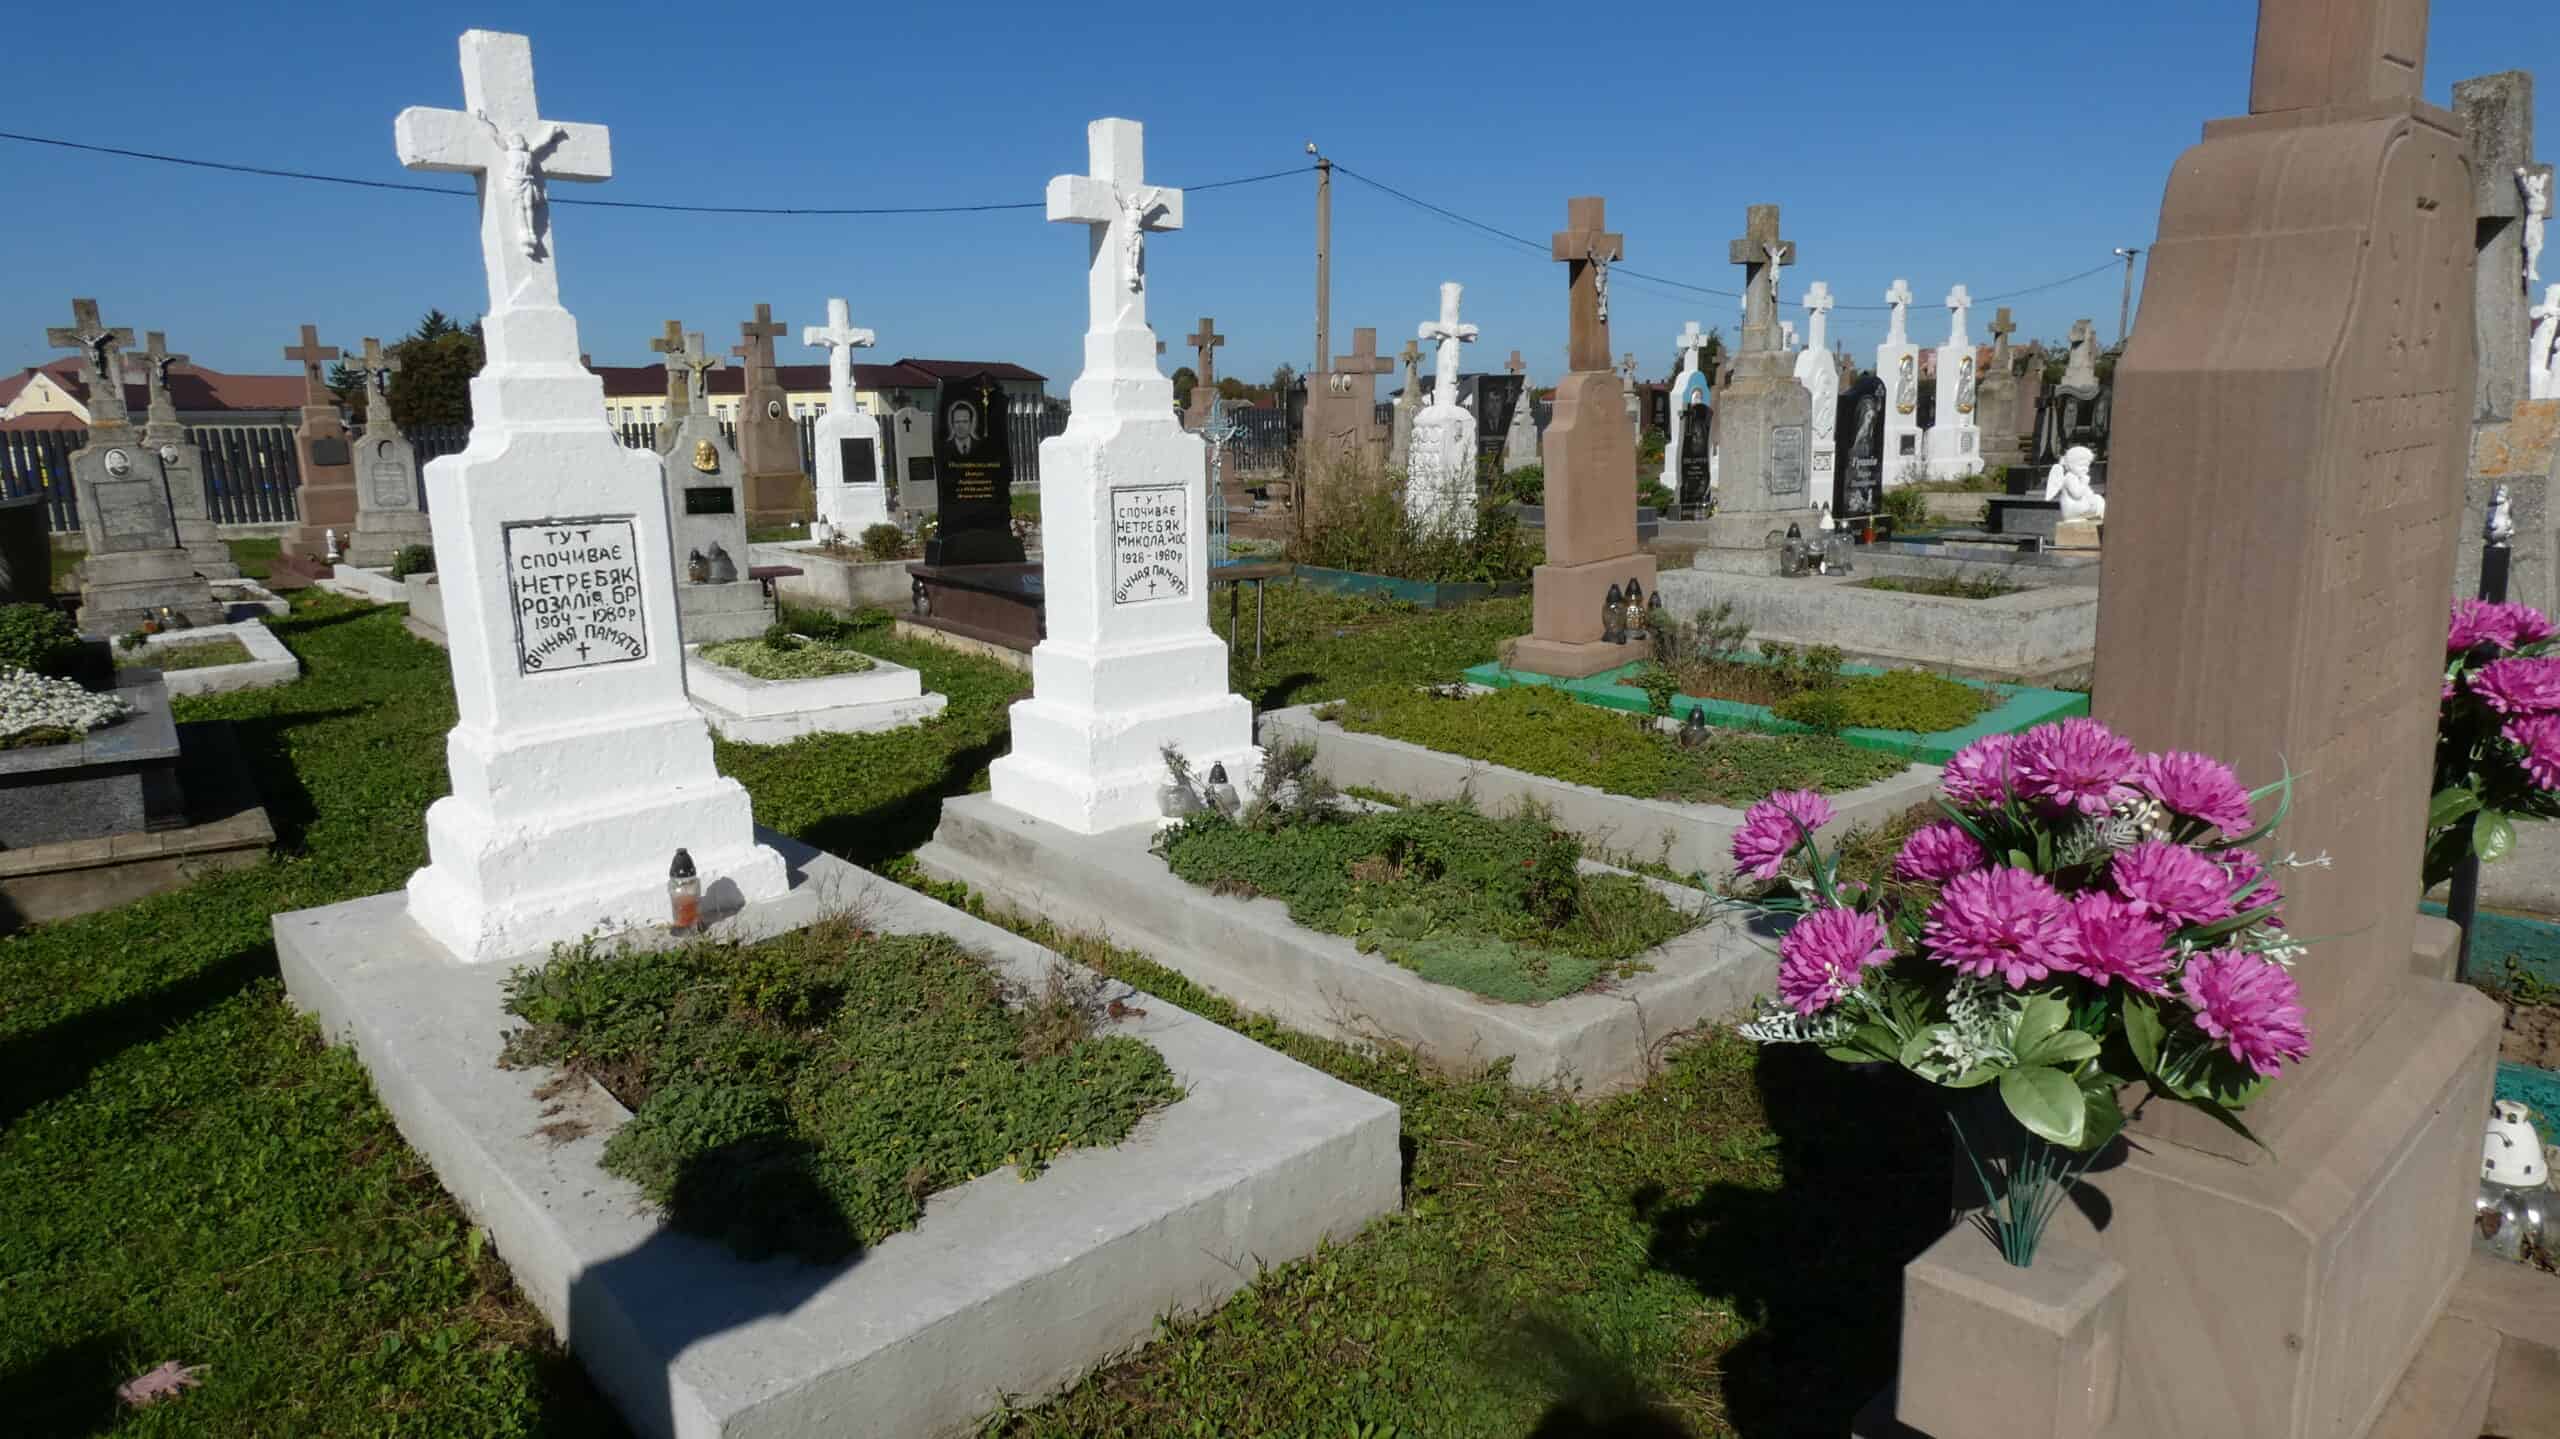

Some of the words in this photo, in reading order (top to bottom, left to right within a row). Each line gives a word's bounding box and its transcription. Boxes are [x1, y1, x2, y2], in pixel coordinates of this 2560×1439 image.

[1134, 494, 1162, 504] ТУТ
[1119, 505, 1176, 518] СПОЧИВАЄ
[1117, 520, 1180, 534] НЕТРЕБЯК
[544, 530, 591, 545] ТУТ
[521, 545, 623, 569] СПОЧИВАЄ
[521, 567, 634, 595] НЕТРЕБЯК
[535, 613, 571, 630] 1904
